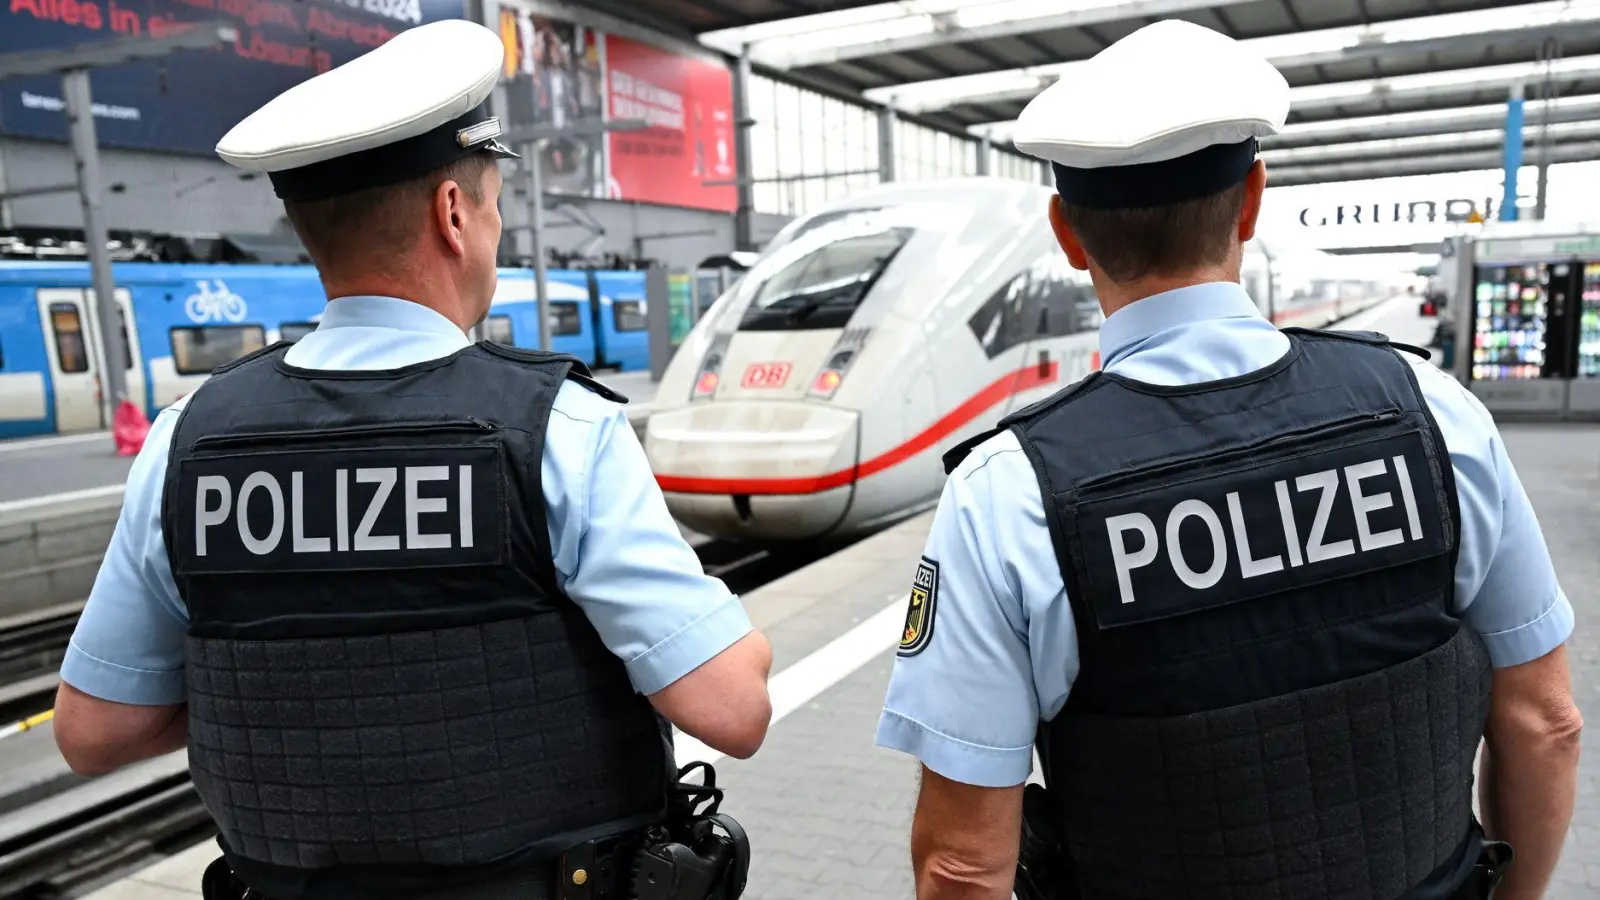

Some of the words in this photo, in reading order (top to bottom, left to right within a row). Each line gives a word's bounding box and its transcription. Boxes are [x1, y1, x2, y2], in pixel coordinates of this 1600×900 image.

[109, 0, 140, 36] in
[745, 364, 788, 386] DB
[195, 464, 474, 557] POLIZEI
[1105, 455, 1424, 604] POLIZEI
